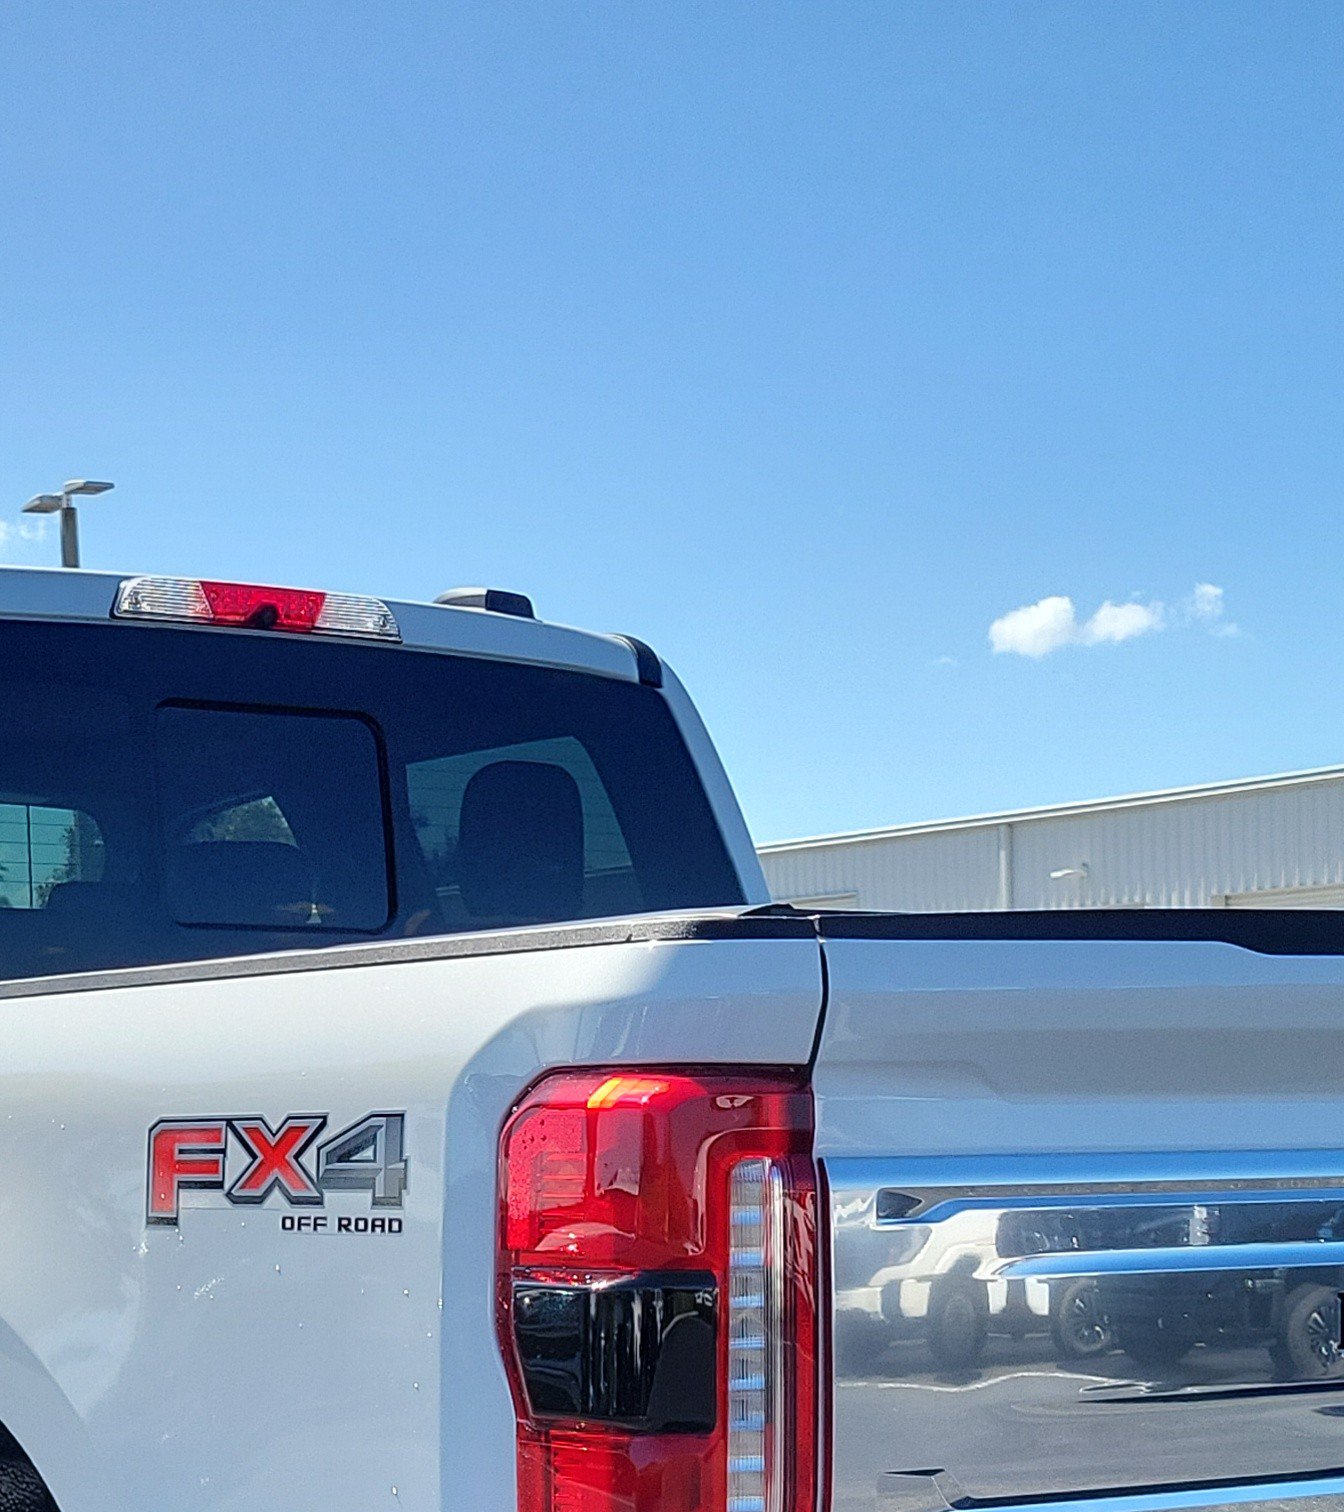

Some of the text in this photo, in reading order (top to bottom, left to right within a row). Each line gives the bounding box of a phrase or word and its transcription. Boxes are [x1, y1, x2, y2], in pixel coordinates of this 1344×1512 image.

[146, 1110, 409, 1229] FX4
[281, 1215, 403, 1234] OFF ROAD
